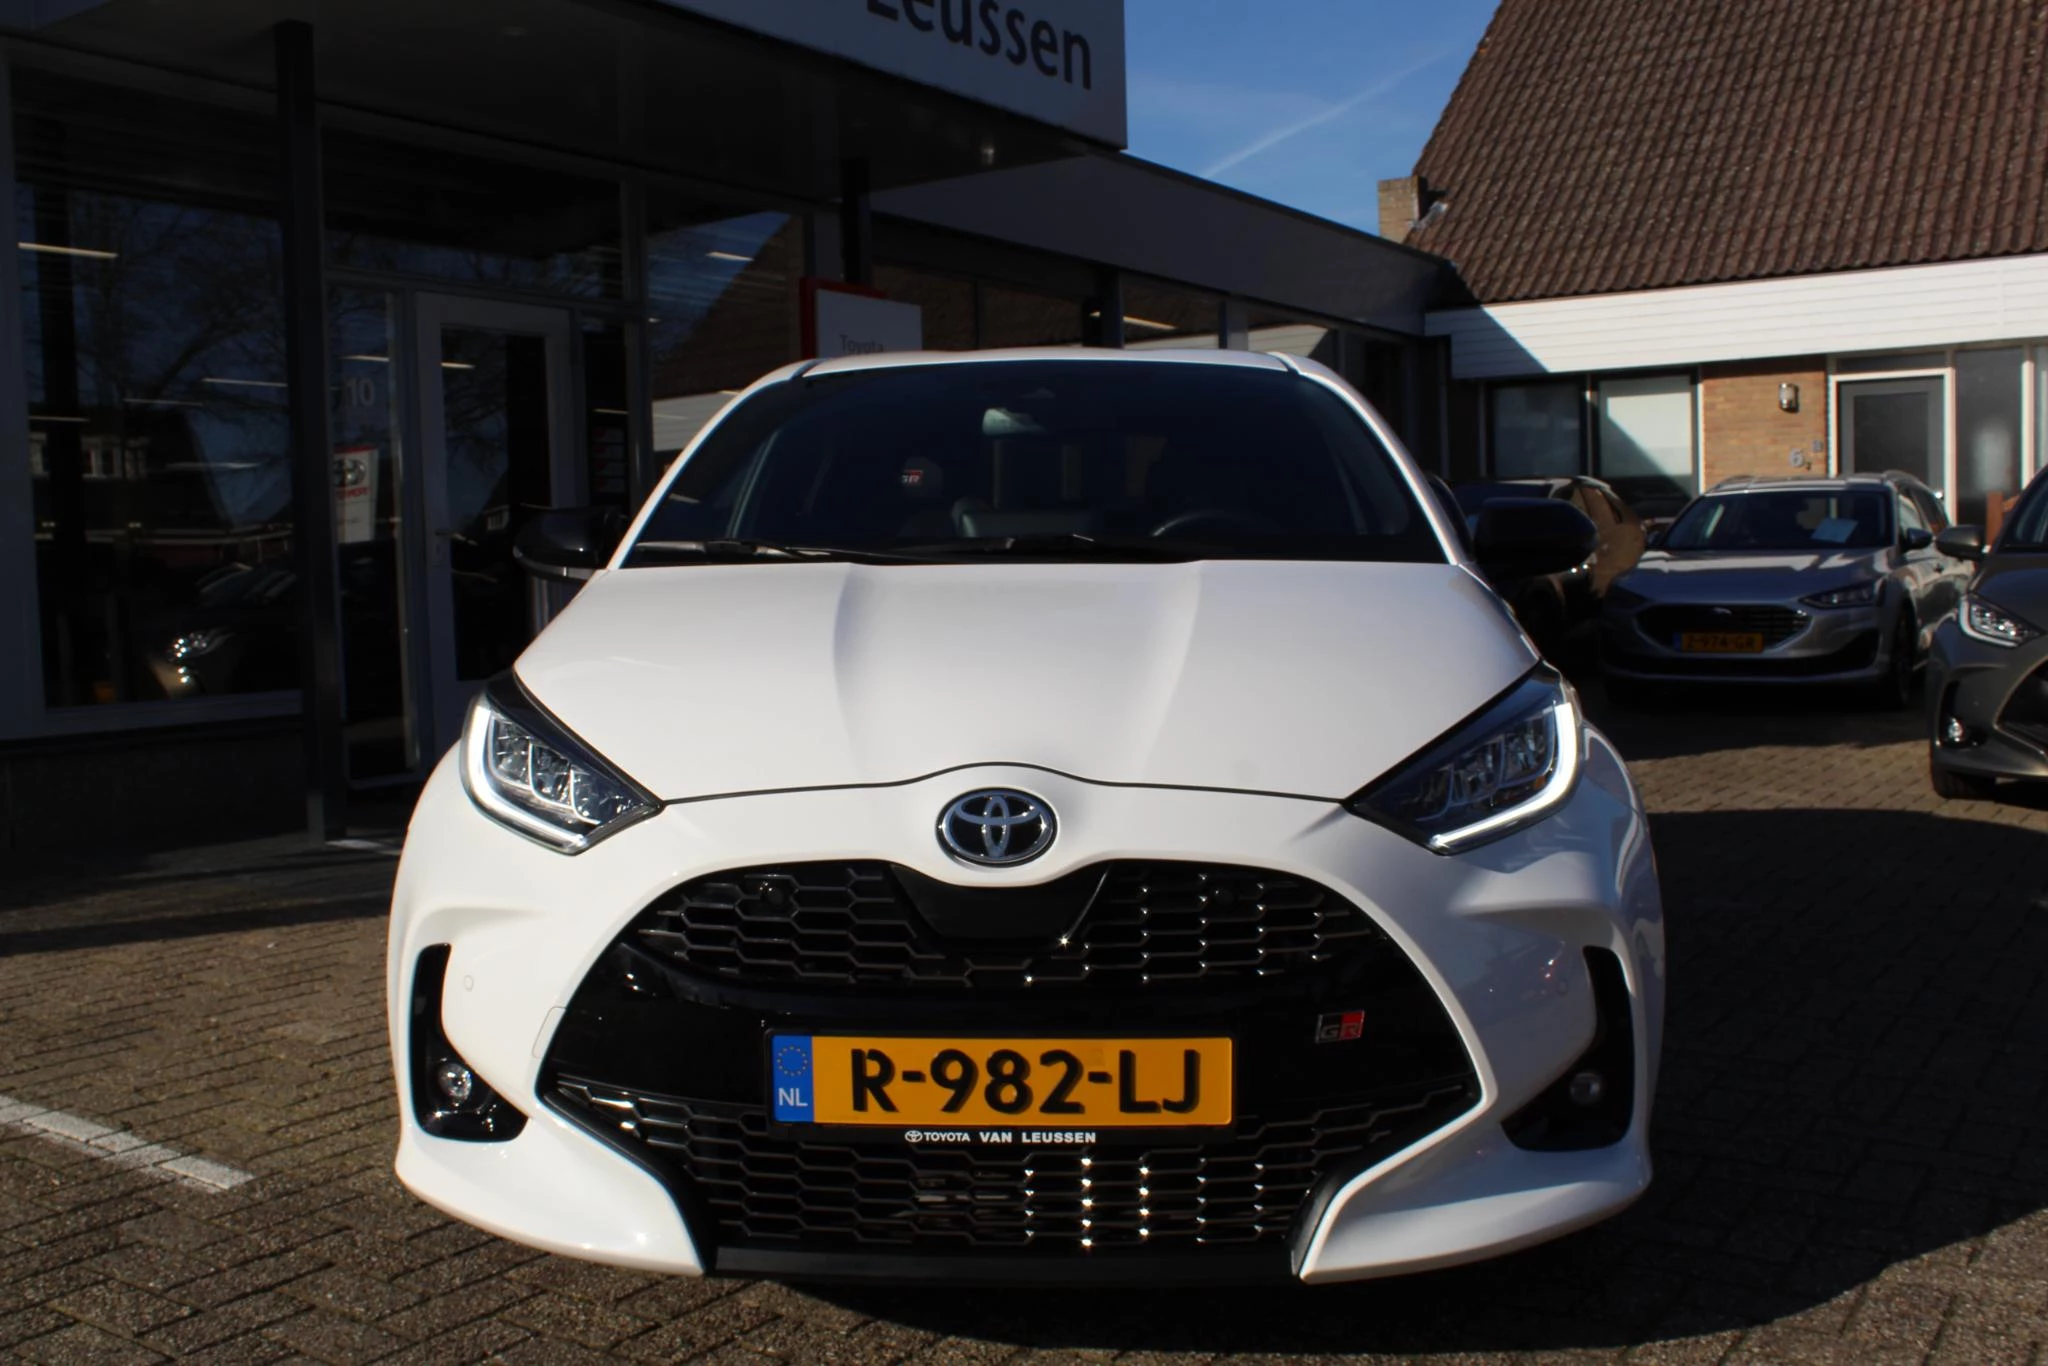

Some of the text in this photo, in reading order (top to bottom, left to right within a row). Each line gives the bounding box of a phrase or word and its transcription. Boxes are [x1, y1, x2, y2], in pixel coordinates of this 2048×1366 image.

[867, 0, 1092, 90] eussen
[1319, 1022, 1362, 1040] GR
[851, 1048, 1202, 1114] R-982-LJ
[778, 1087, 808, 1107] NL
[923, 1131, 1096, 1144] TOYOTA VAN LEUSSEN
